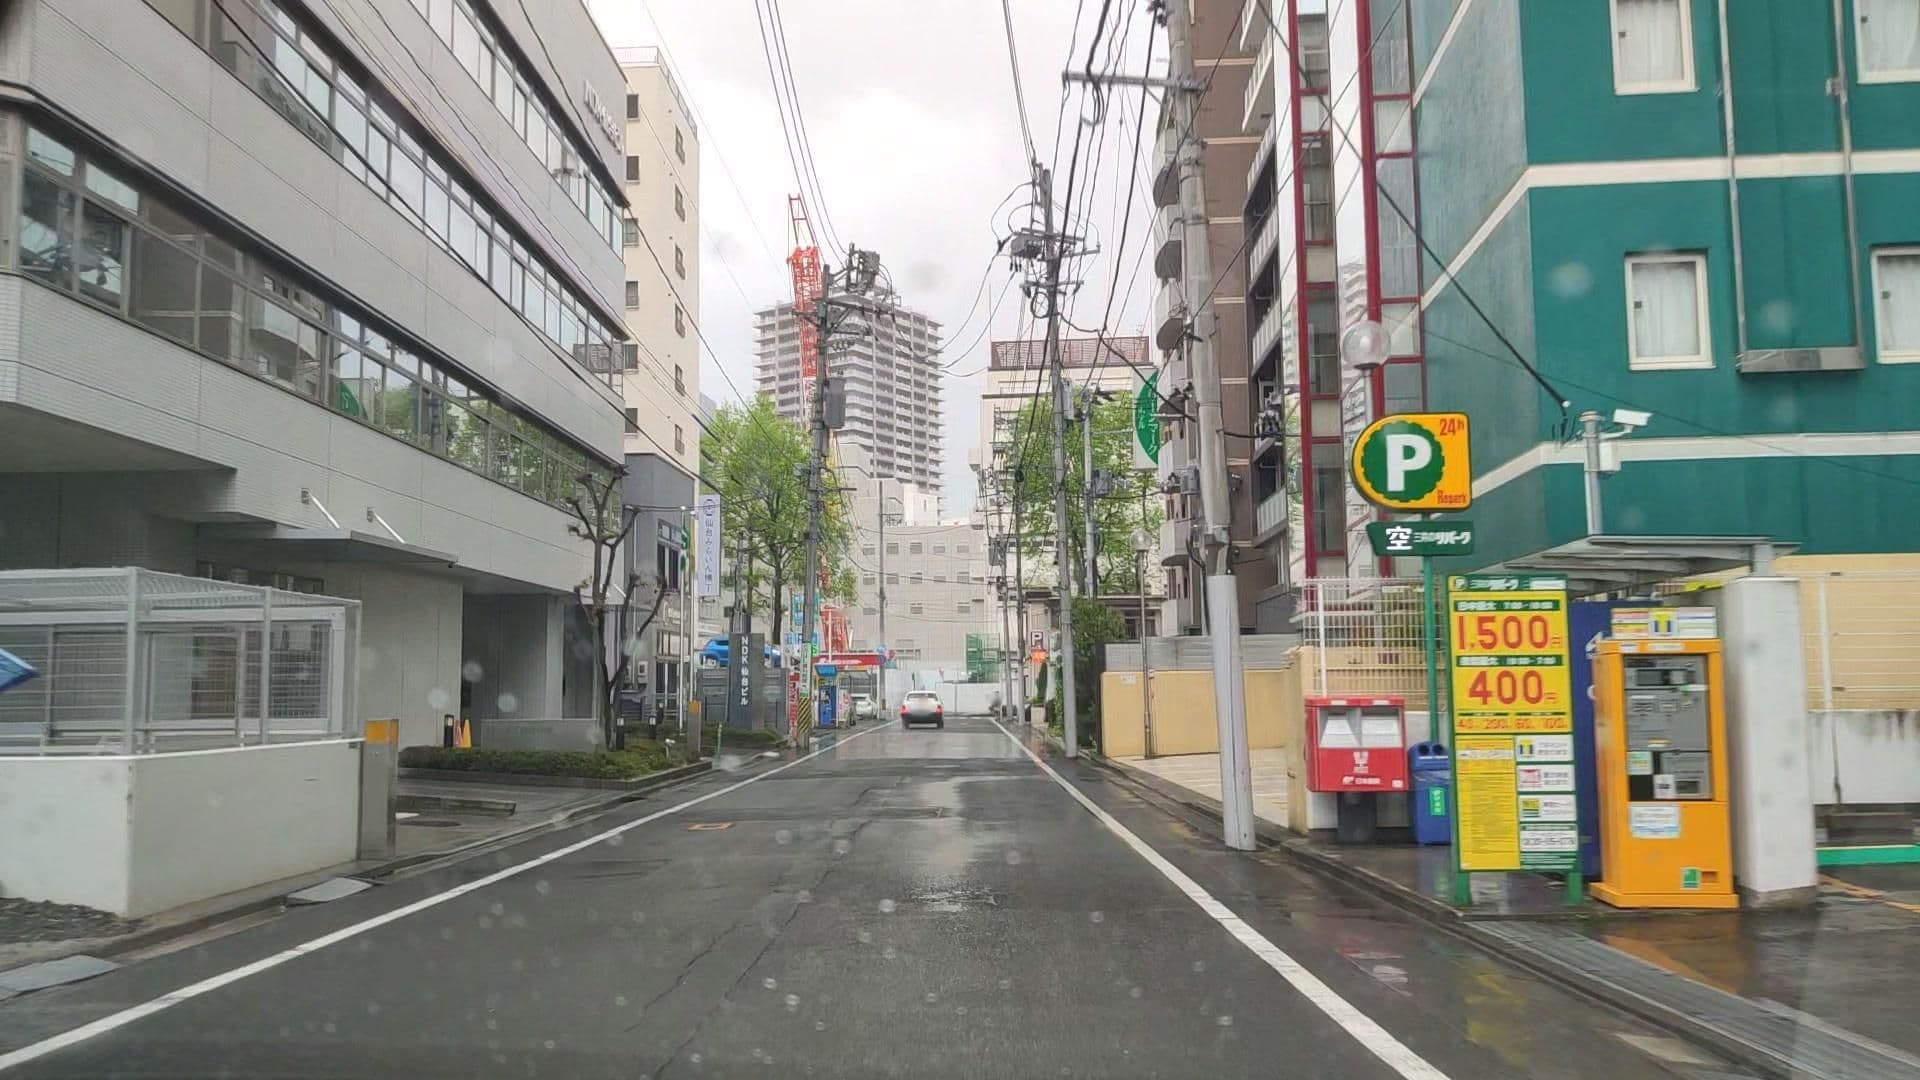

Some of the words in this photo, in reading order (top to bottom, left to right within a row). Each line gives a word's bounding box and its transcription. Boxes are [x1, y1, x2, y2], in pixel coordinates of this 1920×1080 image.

[1385, 433, 1432, 492] P
[1385, 526, 1413, 550] 空
[1468, 670, 1543, 705] 400
